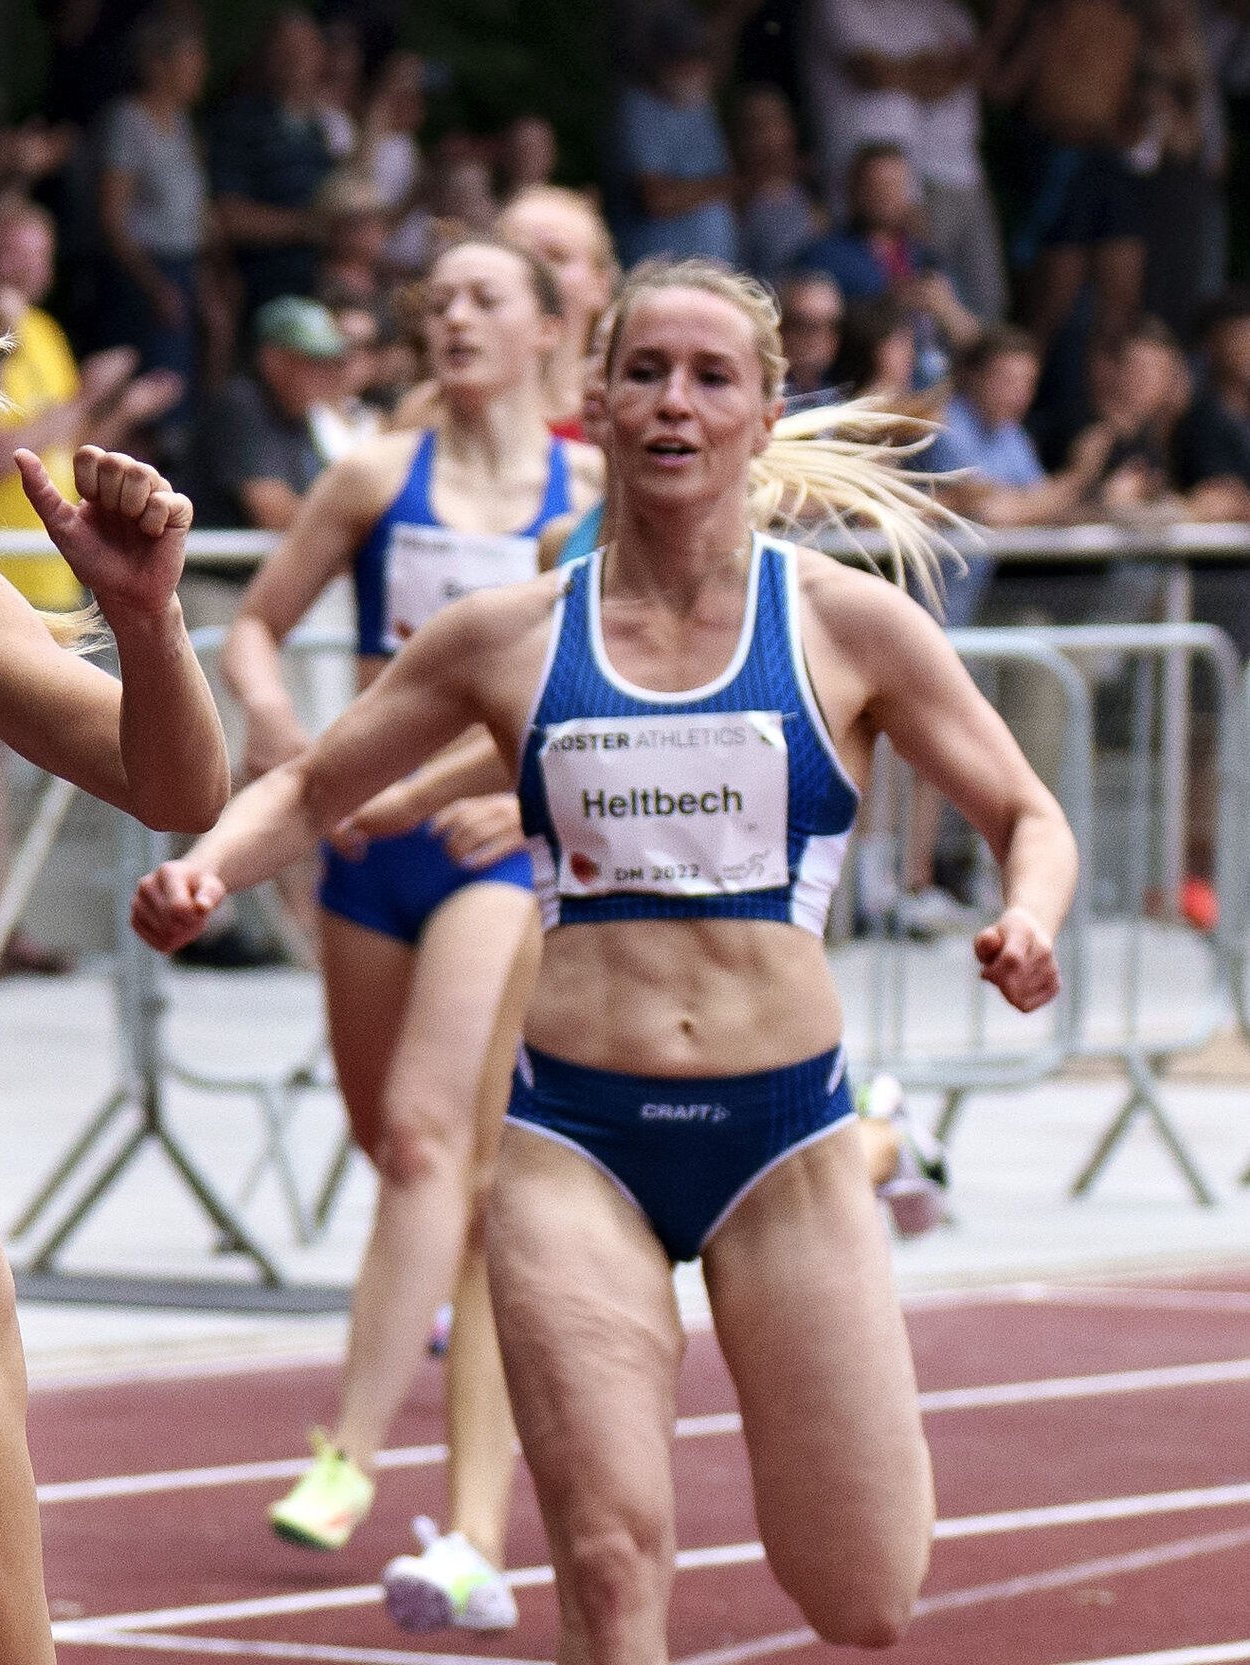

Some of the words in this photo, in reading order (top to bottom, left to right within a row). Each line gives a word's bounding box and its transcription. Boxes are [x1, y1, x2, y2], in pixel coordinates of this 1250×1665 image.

[636, 726, 747, 748] ATHLETICS
[581, 785, 743, 818] Heltbech
[614, 867, 644, 881] DM
[651, 863, 700, 881] 2022
[641, 1103, 712, 1121] CRAFT
